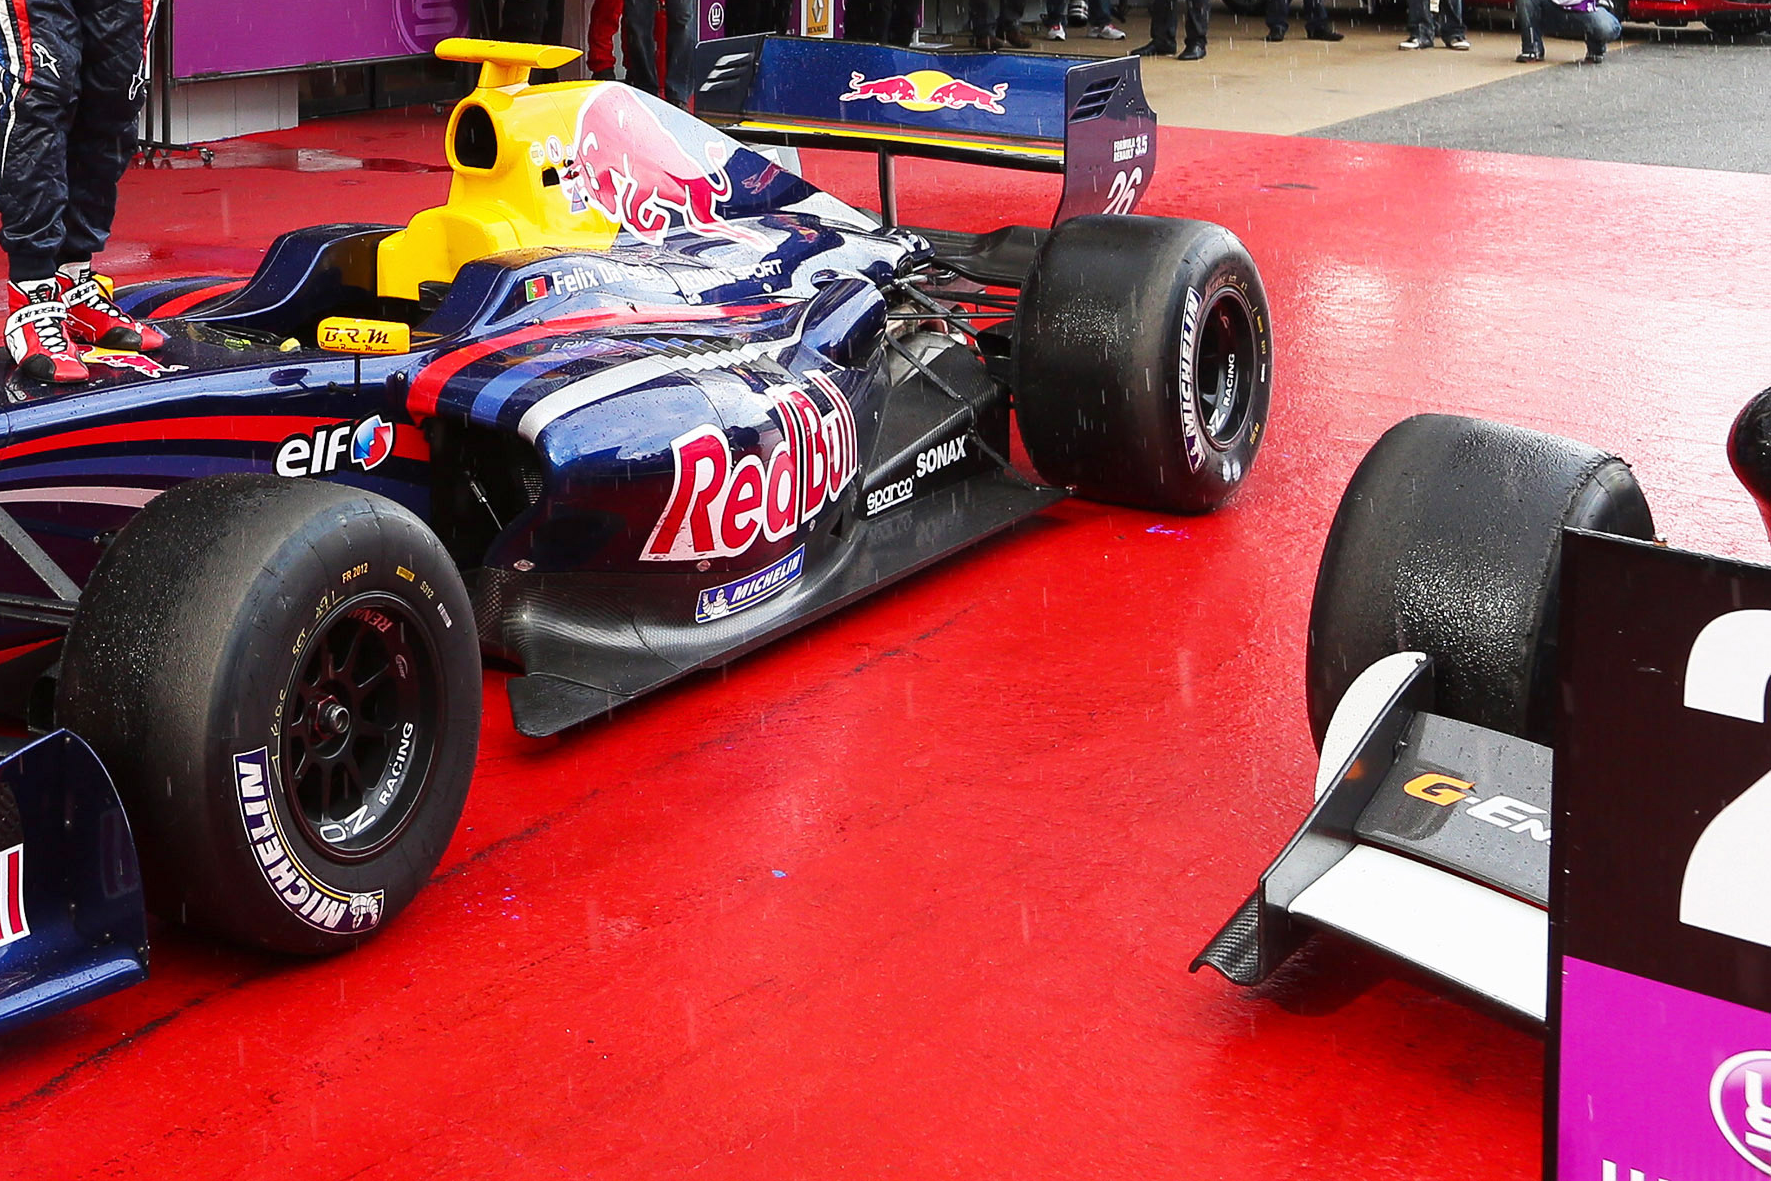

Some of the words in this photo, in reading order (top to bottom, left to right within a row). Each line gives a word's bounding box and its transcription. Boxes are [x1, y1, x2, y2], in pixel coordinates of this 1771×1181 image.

[1112, 147, 1135, 164] RENAULT
[1134, 134, 1149, 157] 3.5
[1113, 137, 1136, 152] FORMULA
[1101, 166, 1144, 216] 26
[551, 269, 600, 296] Felix
[732, 259, 783, 286] SPORT
[1180, 289, 1202, 439] MICHELIN
[1222, 353, 1236, 408] RACING
[276, 426, 350, 477] elf
[644, 387, 800, 557] Red
[793, 369, 859, 522] Bull
[915, 434, 969, 479] SONAX
[866, 477, 914, 512] sparco
[341, 571, 353, 584] FR
[352, 562, 369, 579] 2012
[731, 553, 802, 603] MICHELIN
[378, 721, 415, 807] RACING
[1680, 608, 1771, 948] 2
[236, 759, 347, 931] MICHELIN
